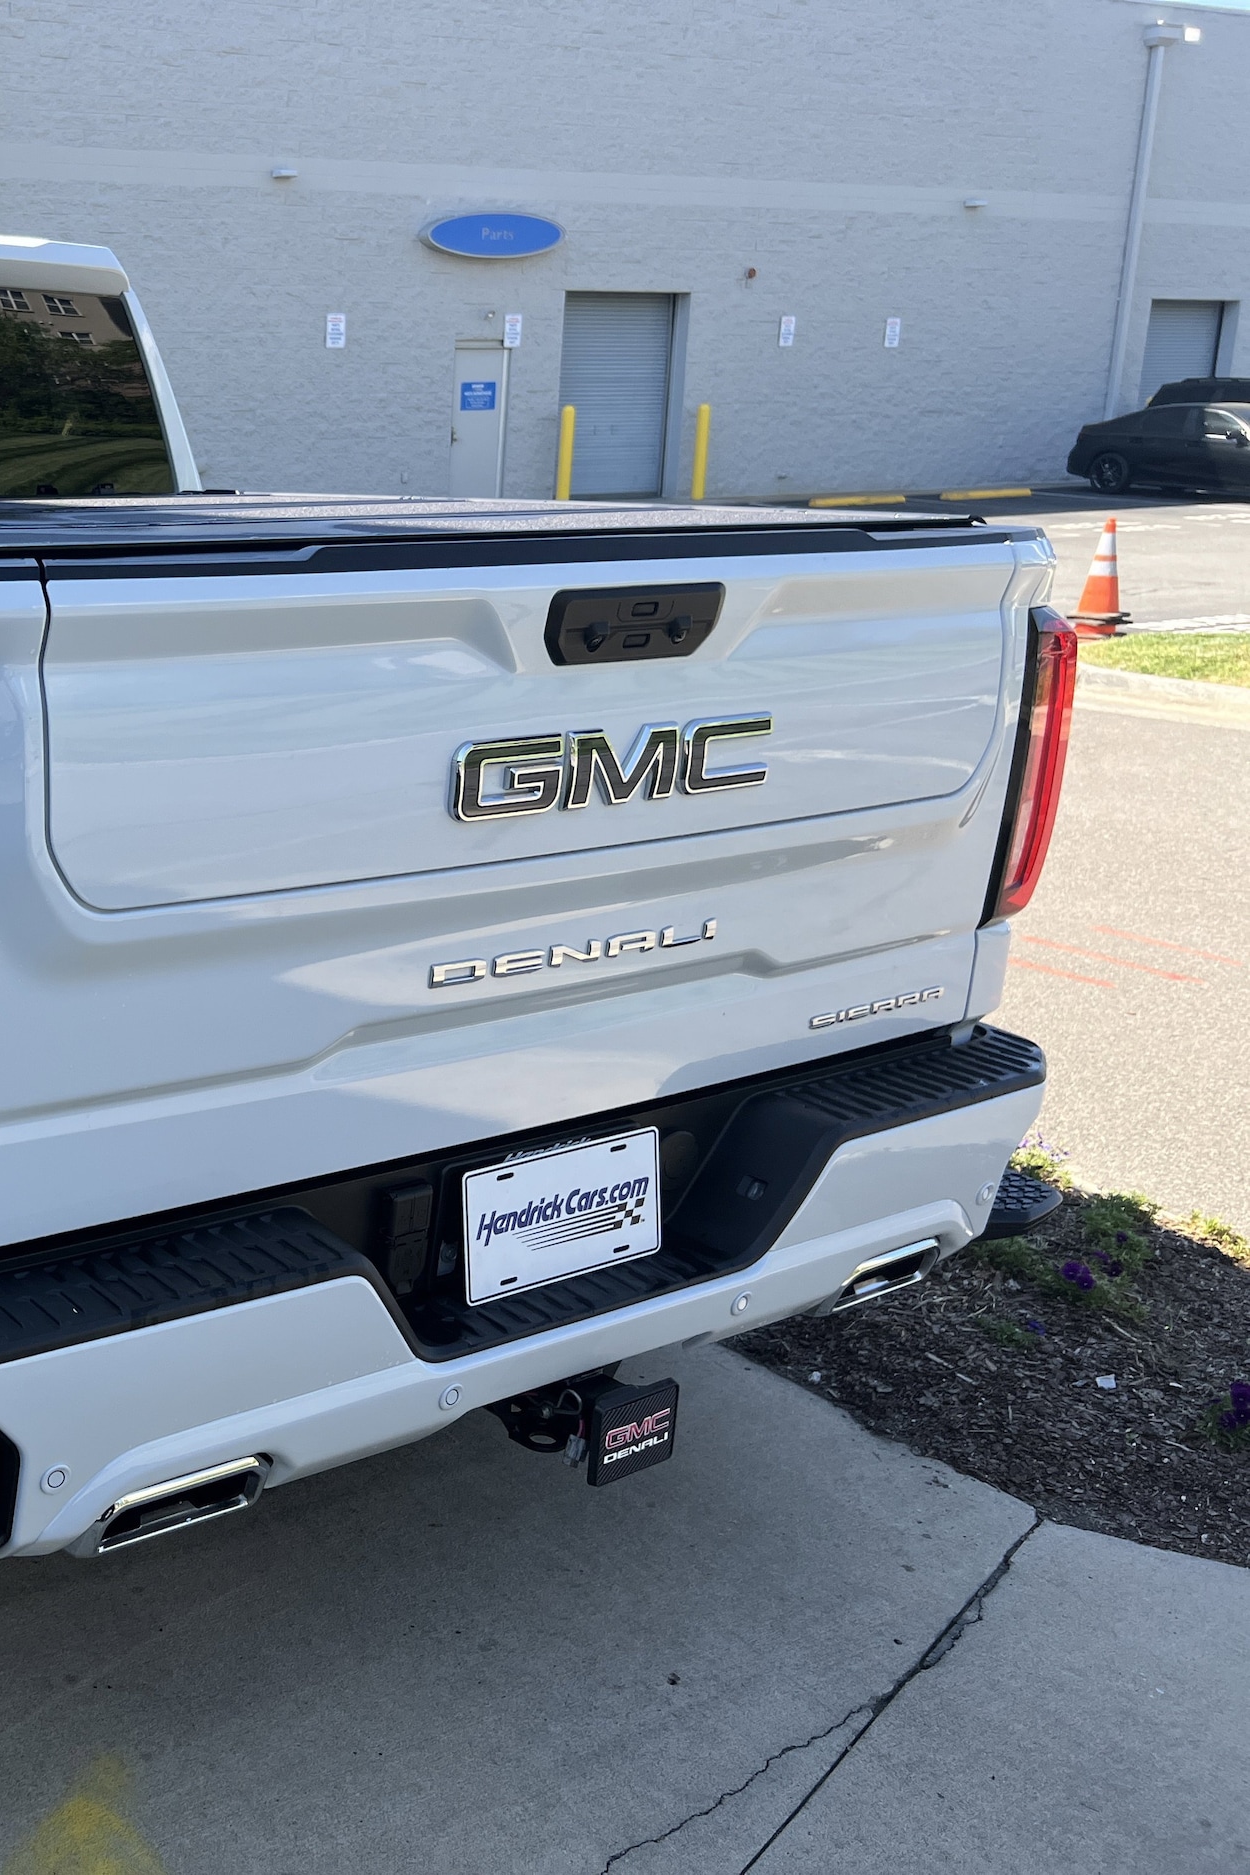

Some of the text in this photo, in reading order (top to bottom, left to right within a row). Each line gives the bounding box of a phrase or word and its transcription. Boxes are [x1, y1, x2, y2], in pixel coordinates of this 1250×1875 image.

[481, 227, 514, 241] Parts
[449, 711, 772, 822] GMC
[427, 917, 717, 989] DENALI
[808, 985, 945, 1029] SIERRA
[603, 1431, 669, 1465] DENALI
[605, 1407, 670, 1450] GMC
